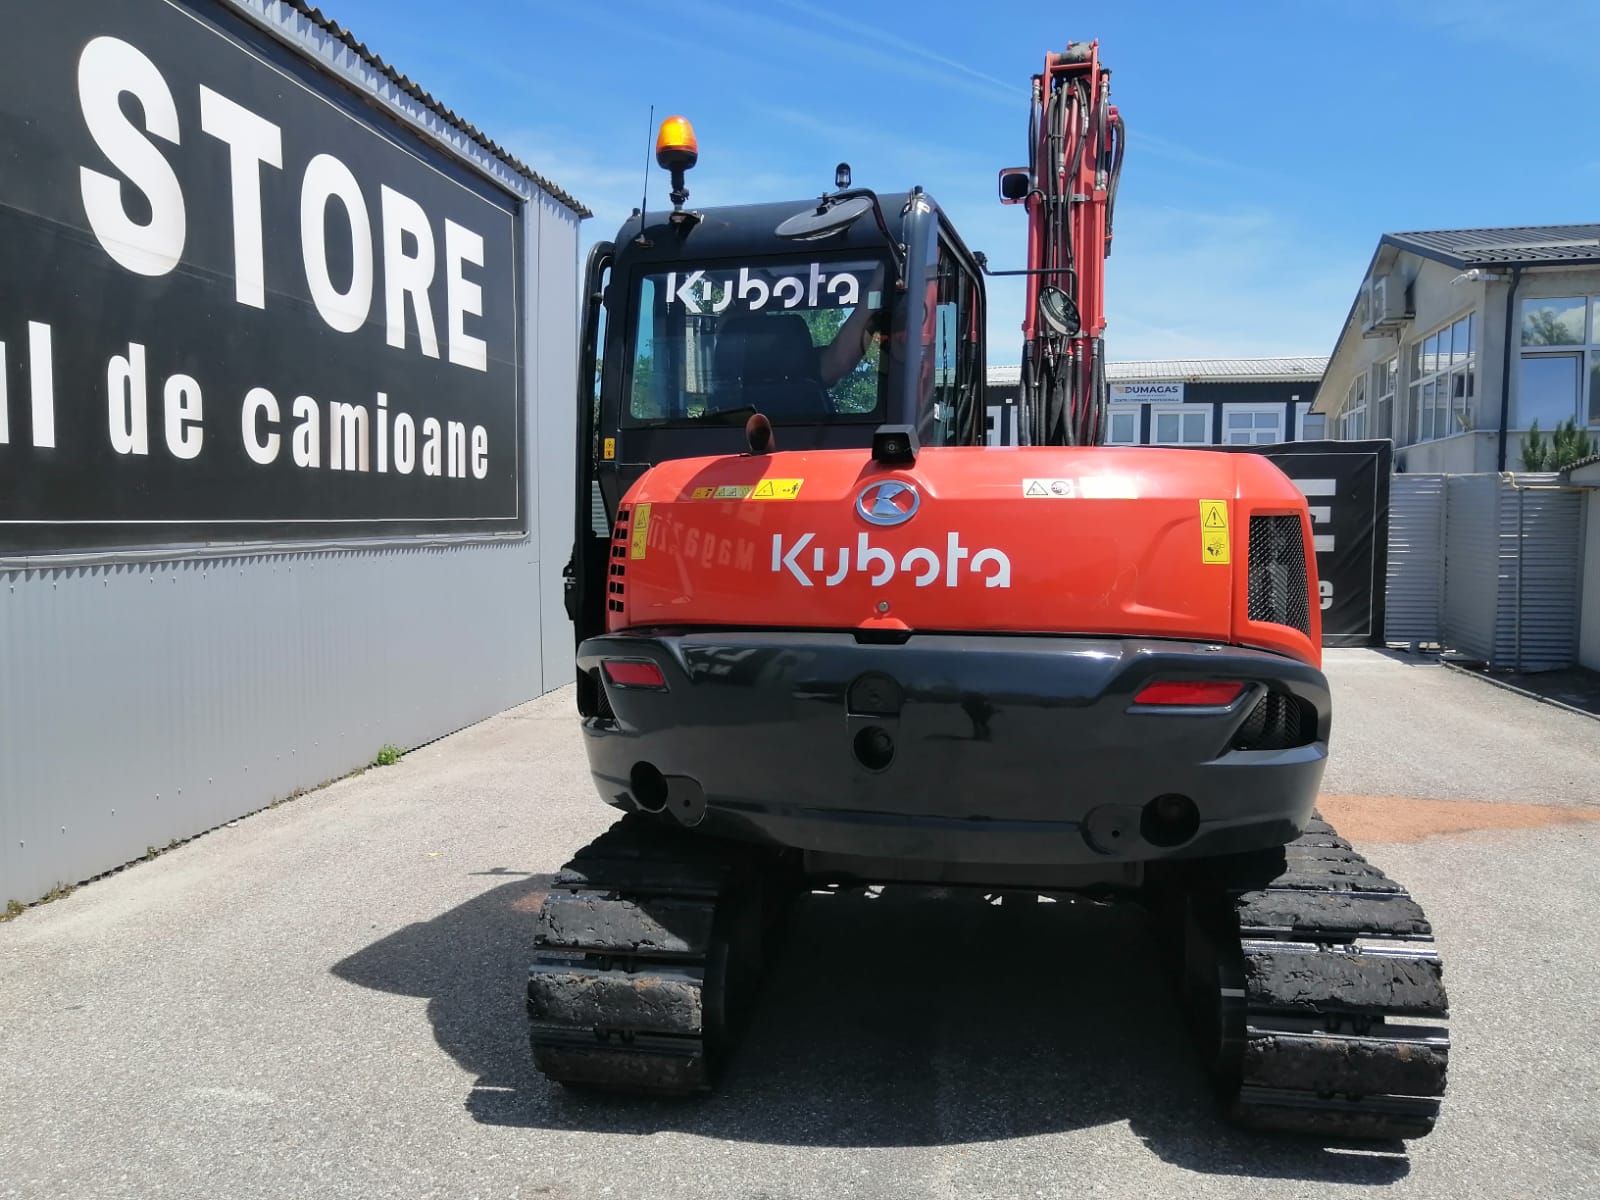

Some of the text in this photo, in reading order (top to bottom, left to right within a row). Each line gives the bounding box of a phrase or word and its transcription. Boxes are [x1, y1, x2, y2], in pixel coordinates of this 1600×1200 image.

[78, 36, 487, 372] STORE
[666, 262, 859, 313] Kubota
[107, 342, 203, 460] de
[241, 387, 488, 480] camioane
[1124, 385, 1179, 394] DUMAGAS
[771, 532, 1011, 588] Kubota
